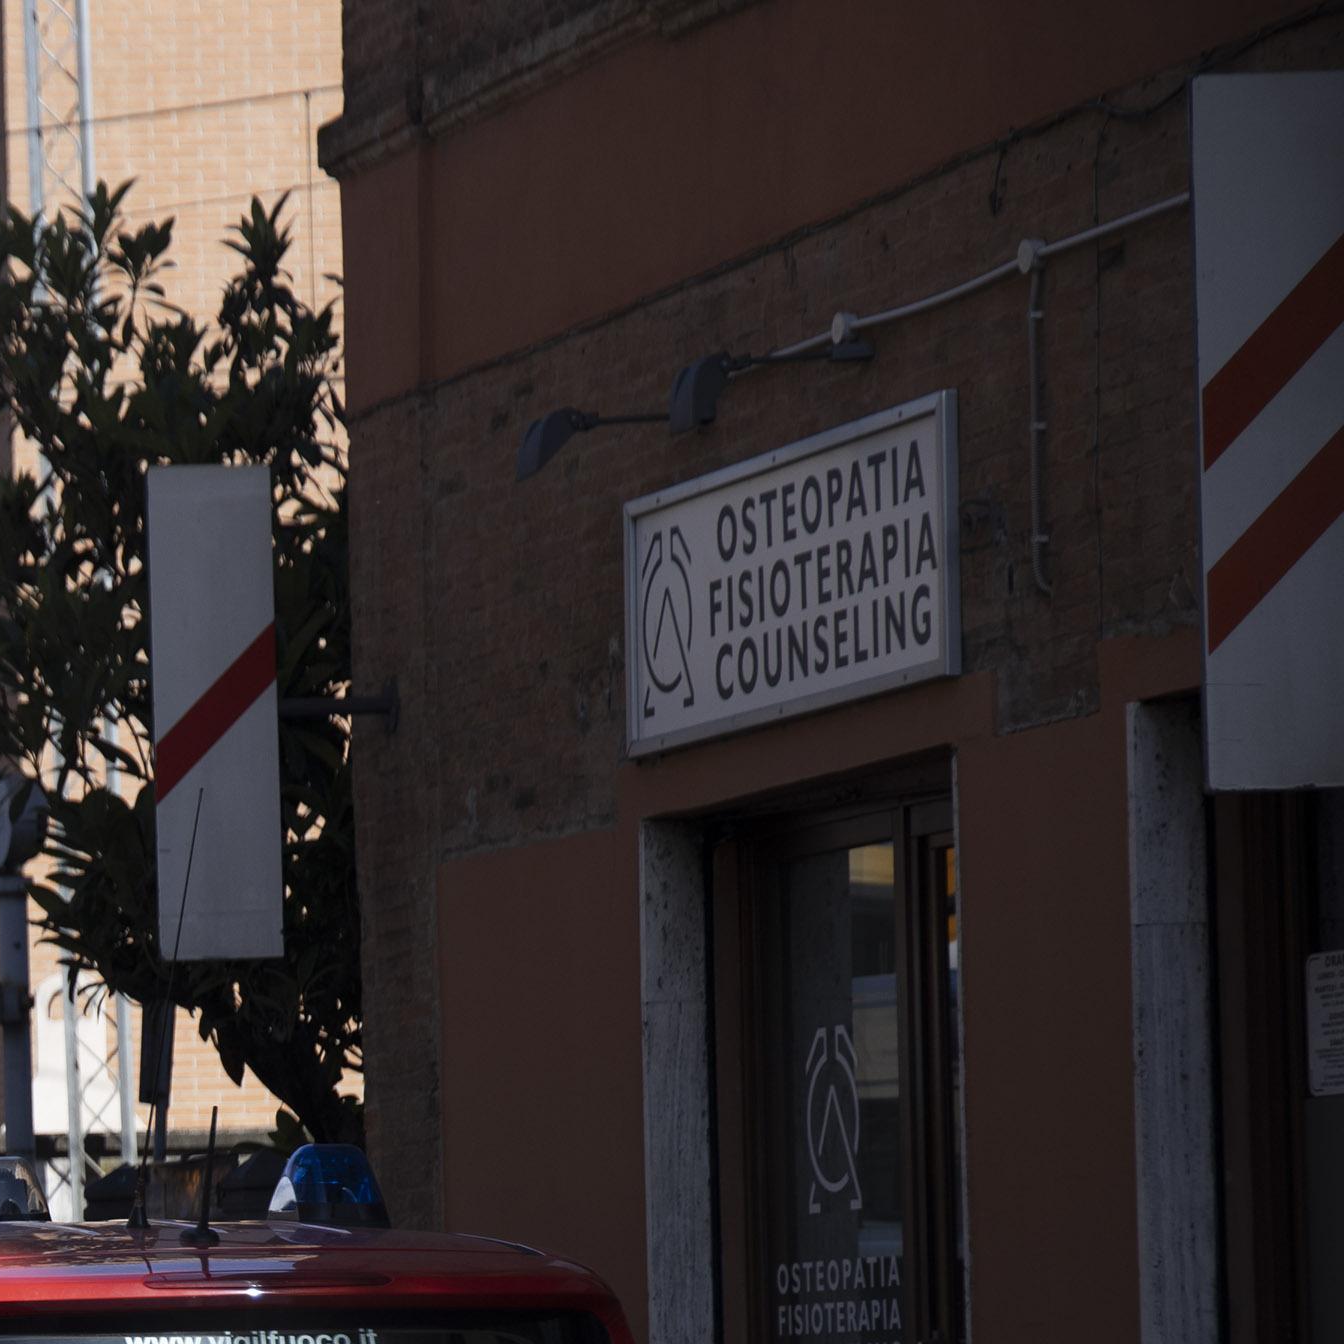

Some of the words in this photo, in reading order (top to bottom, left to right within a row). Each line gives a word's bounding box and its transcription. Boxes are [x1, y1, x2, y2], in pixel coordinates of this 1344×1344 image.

[717, 440, 926, 562] OSTEOPATIA
[709, 512, 938, 637] FISIOTERAPIA
[714, 584, 932, 700] COUNSELING
[777, 1255, 901, 1294] OSTEOPATIA
[778, 1297, 902, 1336] FISIOTERAPIA
